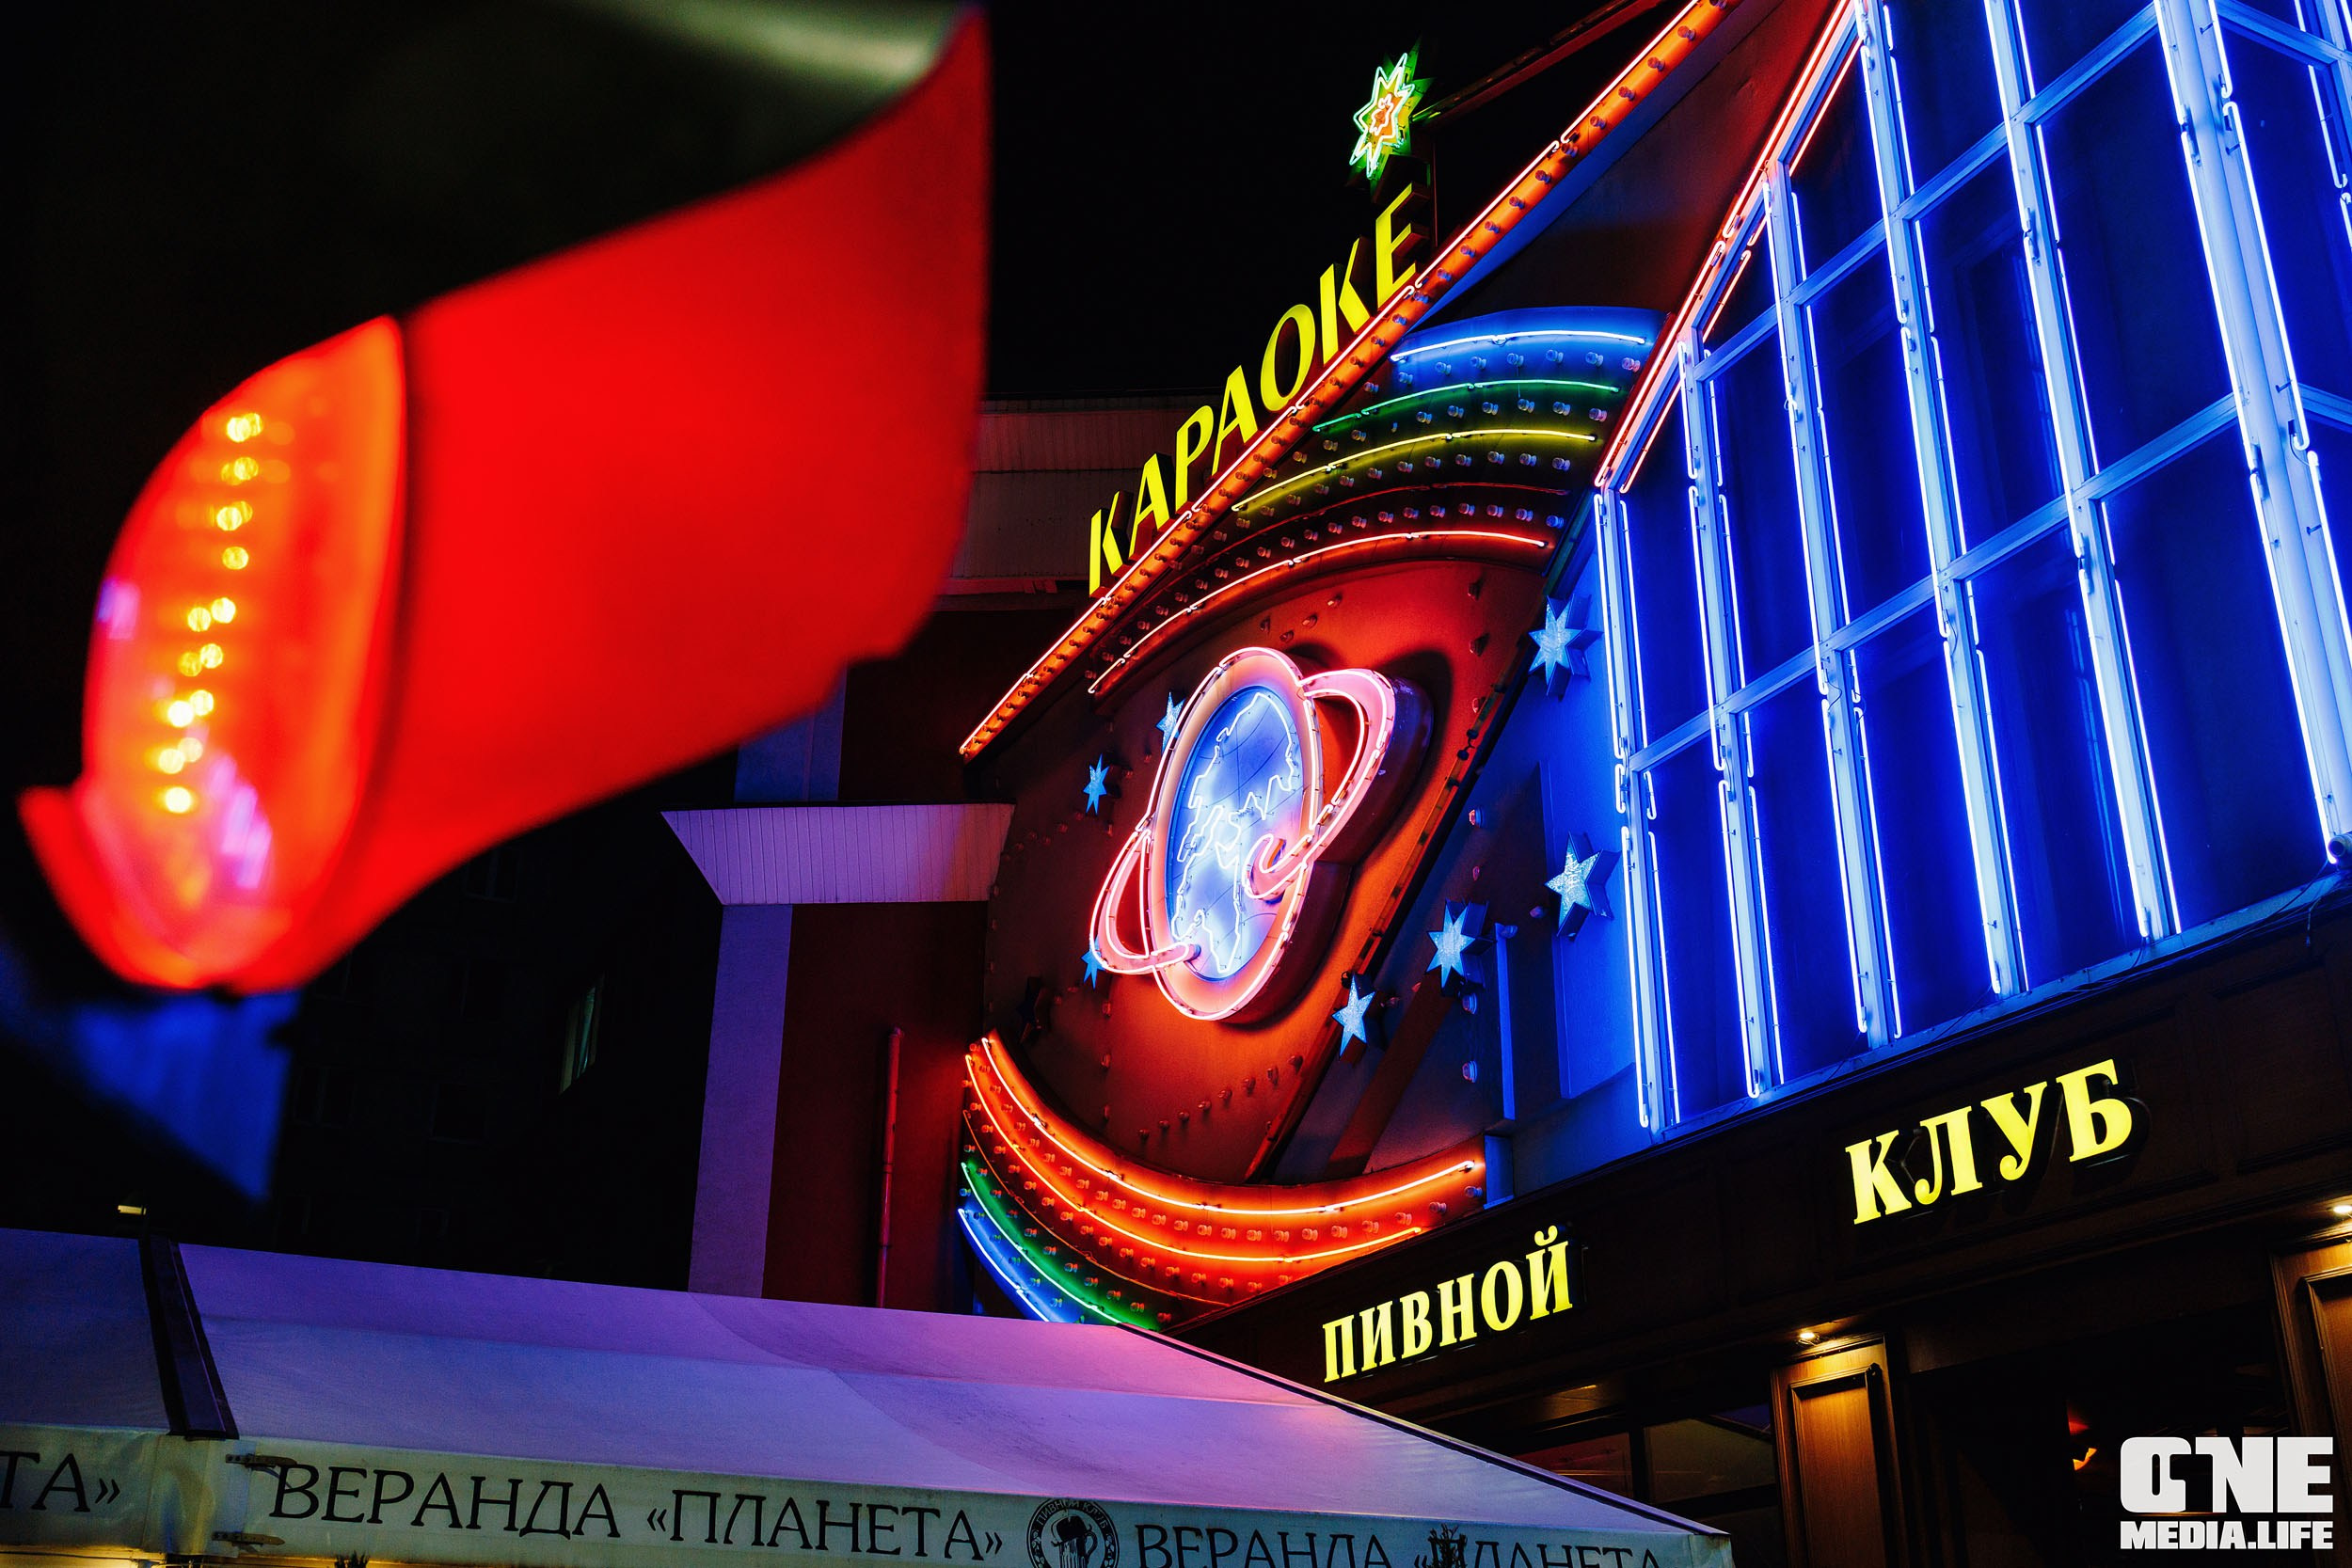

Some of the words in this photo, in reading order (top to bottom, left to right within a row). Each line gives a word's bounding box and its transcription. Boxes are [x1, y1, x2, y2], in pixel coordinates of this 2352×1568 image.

[1089, 182, 1416, 595] КАРАОКЕ
[1323, 1225, 1573, 1383] ПИВНОЙ
[1845, 1058, 2133, 1225] КЛУБ
[269, 1463, 621, 1541] ВЕРАНДА
[646, 1489, 1003, 1561] «ПЛАНЕТА»
[1135, 1524, 1392, 1568] ВЕРАНДА
